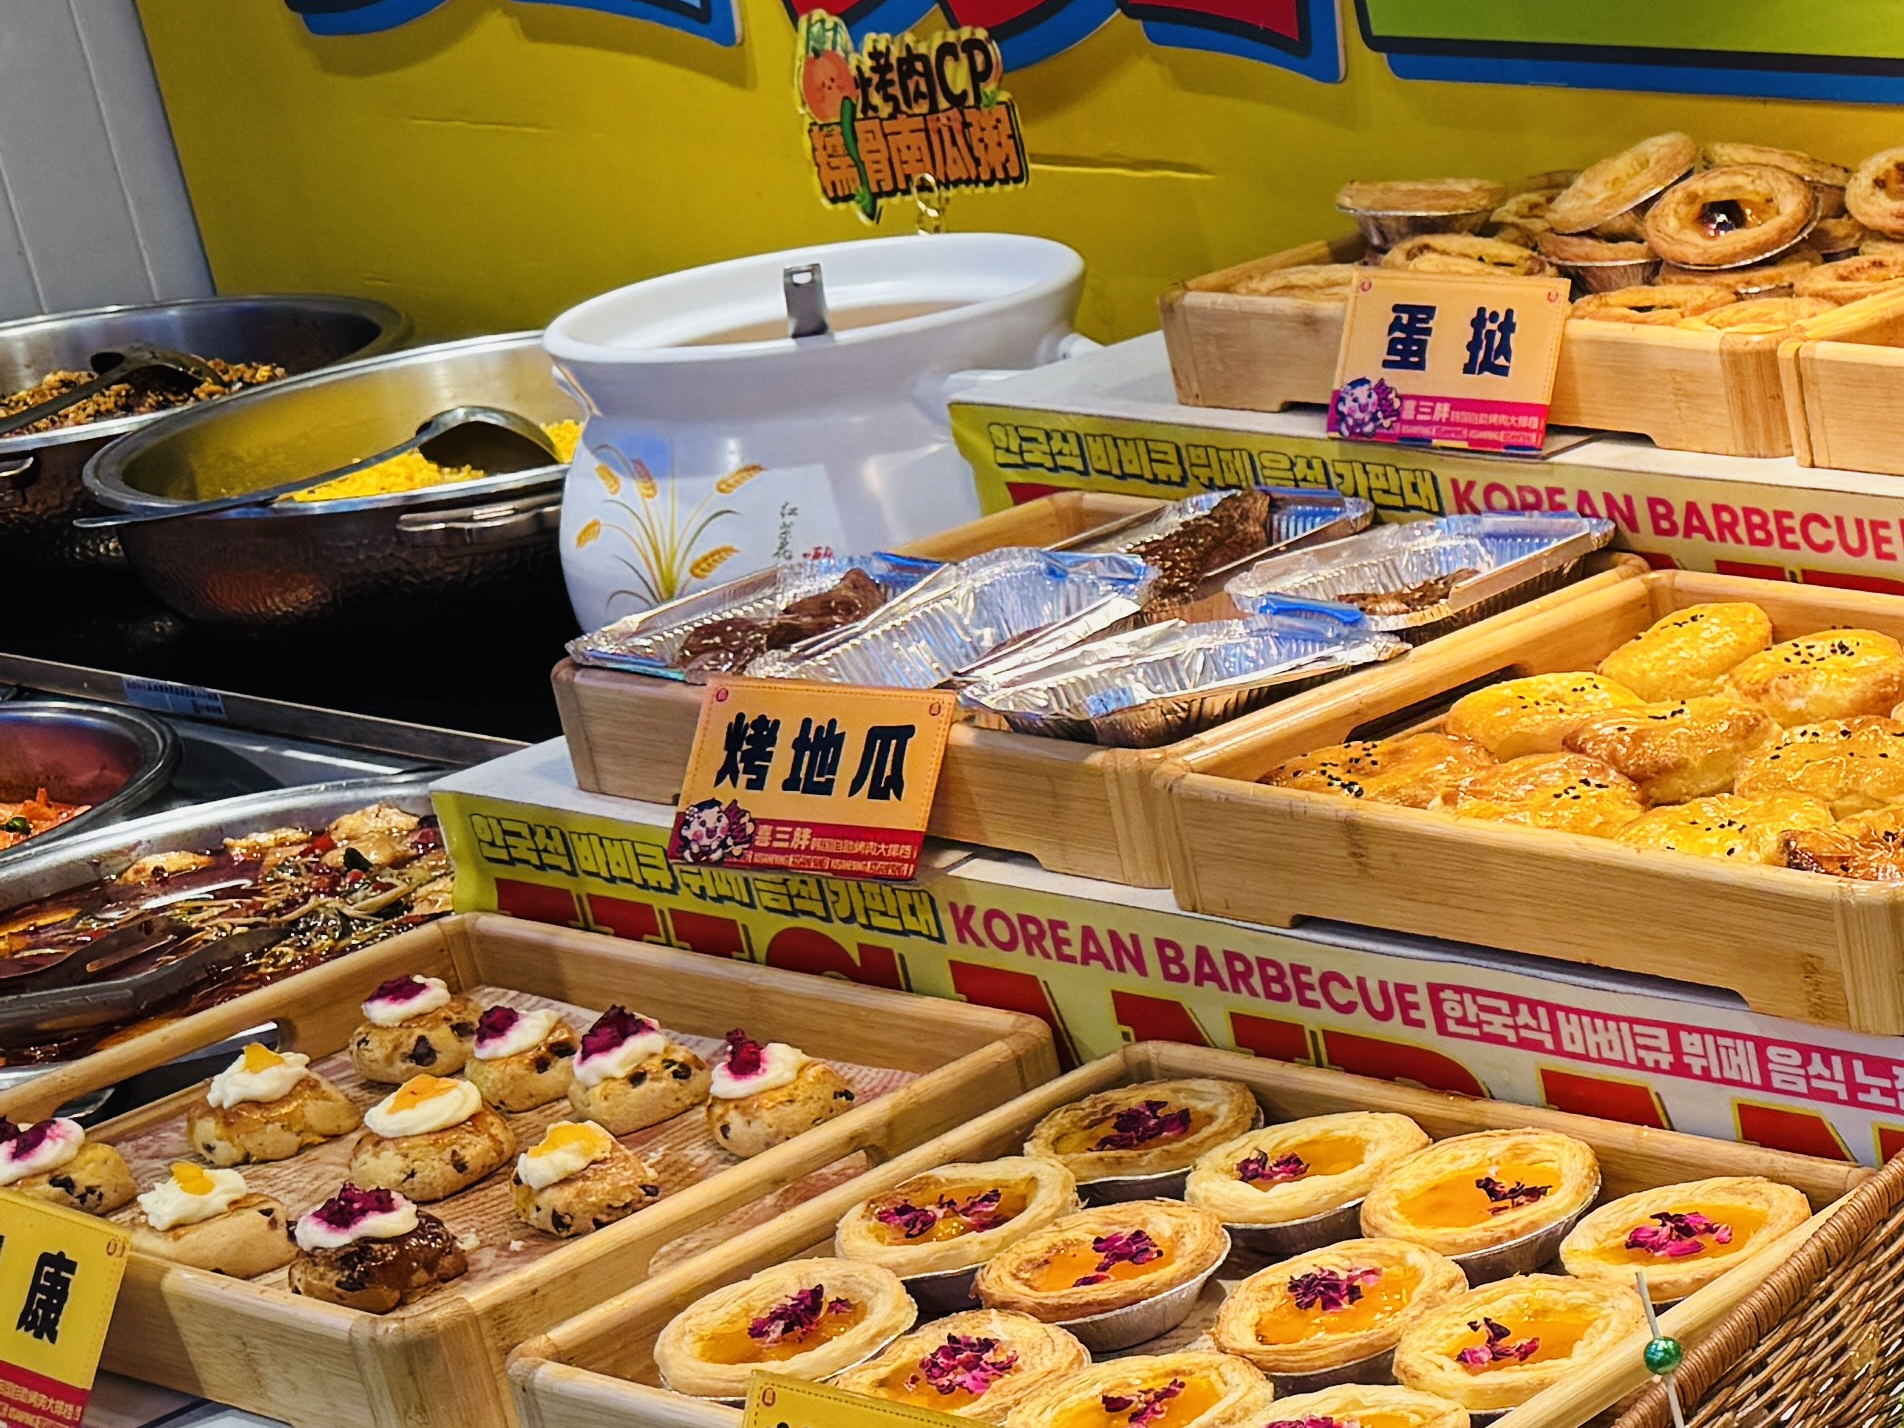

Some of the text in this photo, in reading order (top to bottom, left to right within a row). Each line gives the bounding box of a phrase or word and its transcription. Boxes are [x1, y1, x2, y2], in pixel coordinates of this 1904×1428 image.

[1382, 303, 1518, 378] 蛋挞
[1451, 477, 1896, 562] KOREAN BARBECUE
[713, 711, 917, 802] 烤地瓜
[753, 823, 813, 850] 喜三胖
[948, 900, 1149, 977] KOREAN
[1158, 935, 1427, 1032] BARBECUE
[1439, 990, 1553, 1055] 한국식
[1558, 1008, 1676, 1072] 바비큐
[1682, 1031, 1762, 1088] 뷔페
[1766, 1044, 1849, 1103] 음식
